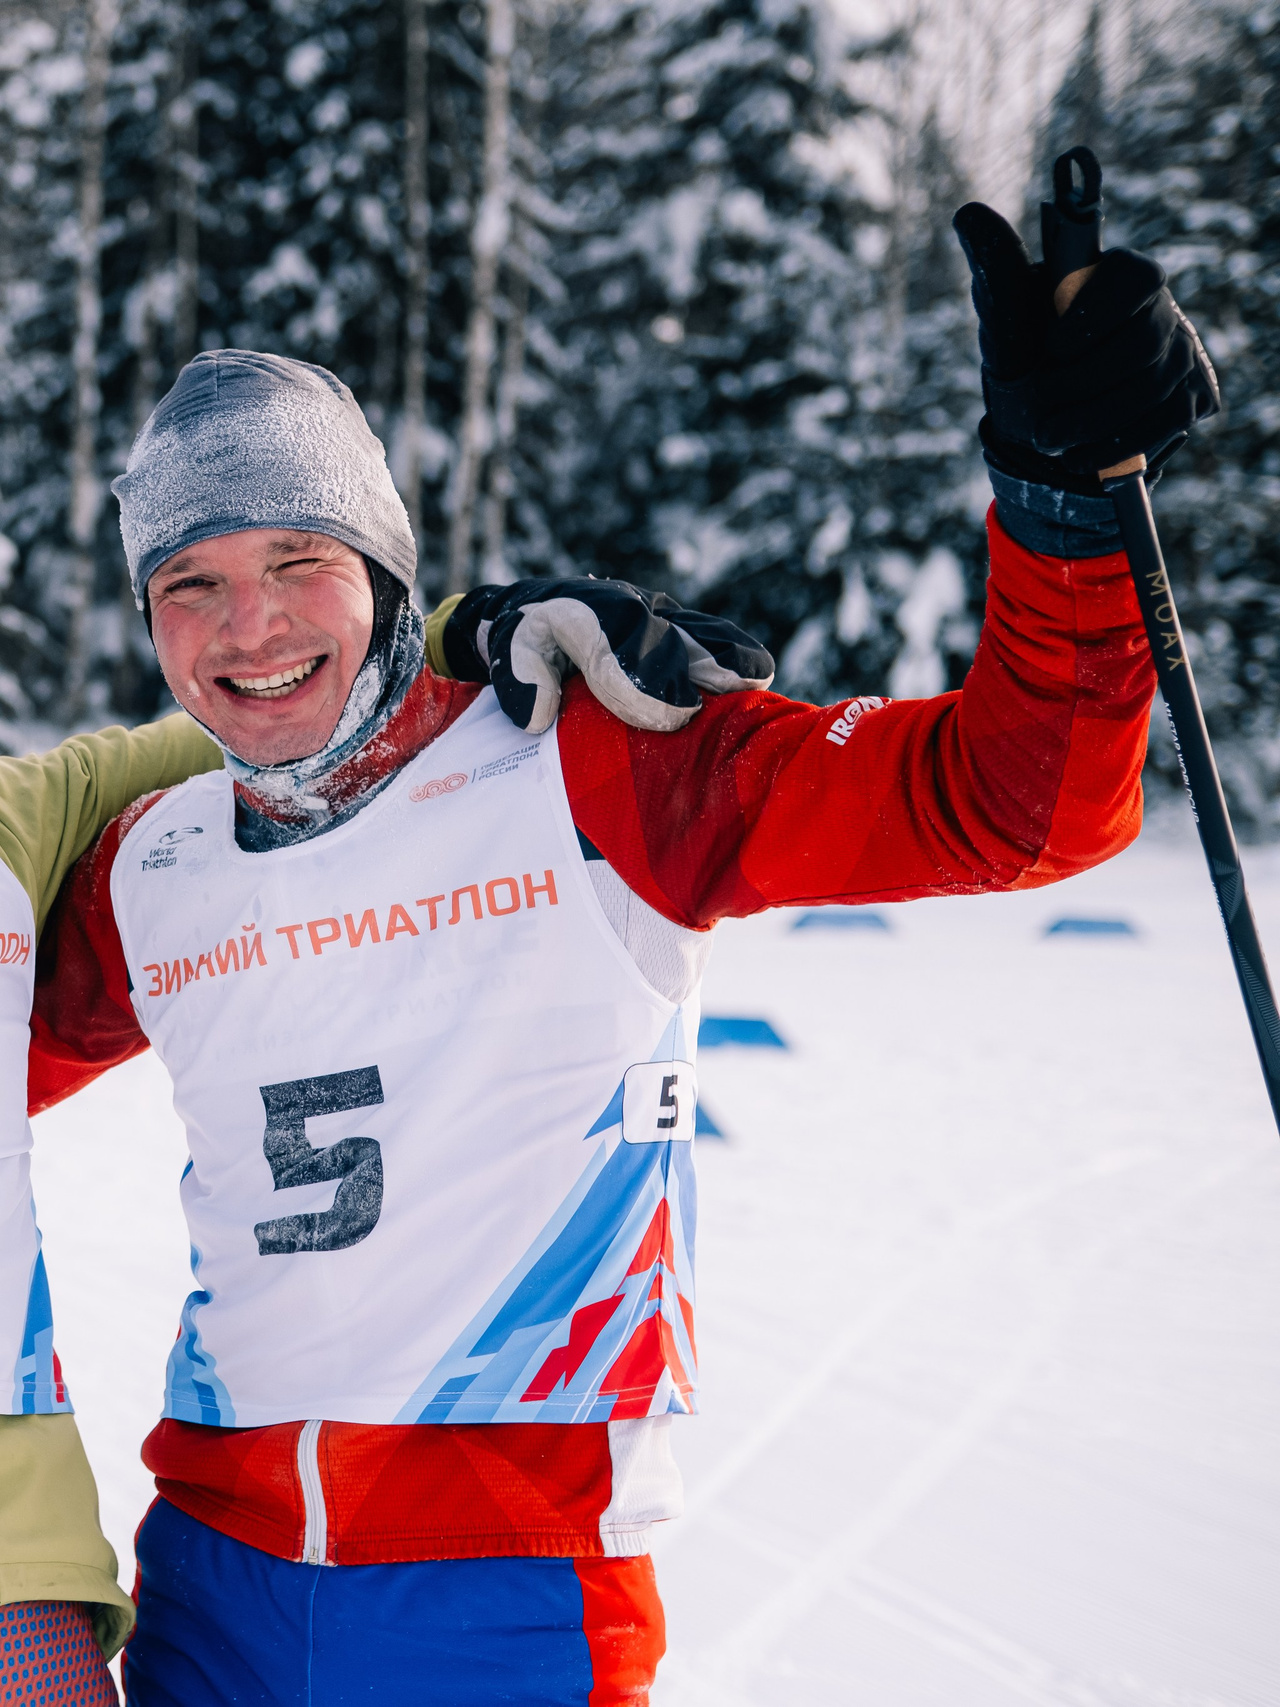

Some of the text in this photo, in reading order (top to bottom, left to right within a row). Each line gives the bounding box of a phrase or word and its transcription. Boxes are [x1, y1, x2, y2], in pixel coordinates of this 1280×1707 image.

[1145, 569, 1187, 672] MOAX
[479, 764, 519, 781] РОССИИ
[481, 749, 539, 774] ТРИАТЛОНА
[276, 869, 559, 960] ТРИАТЛОН
[656, 1074, 679, 1129] 5
[254, 1064, 385, 1257] 5
